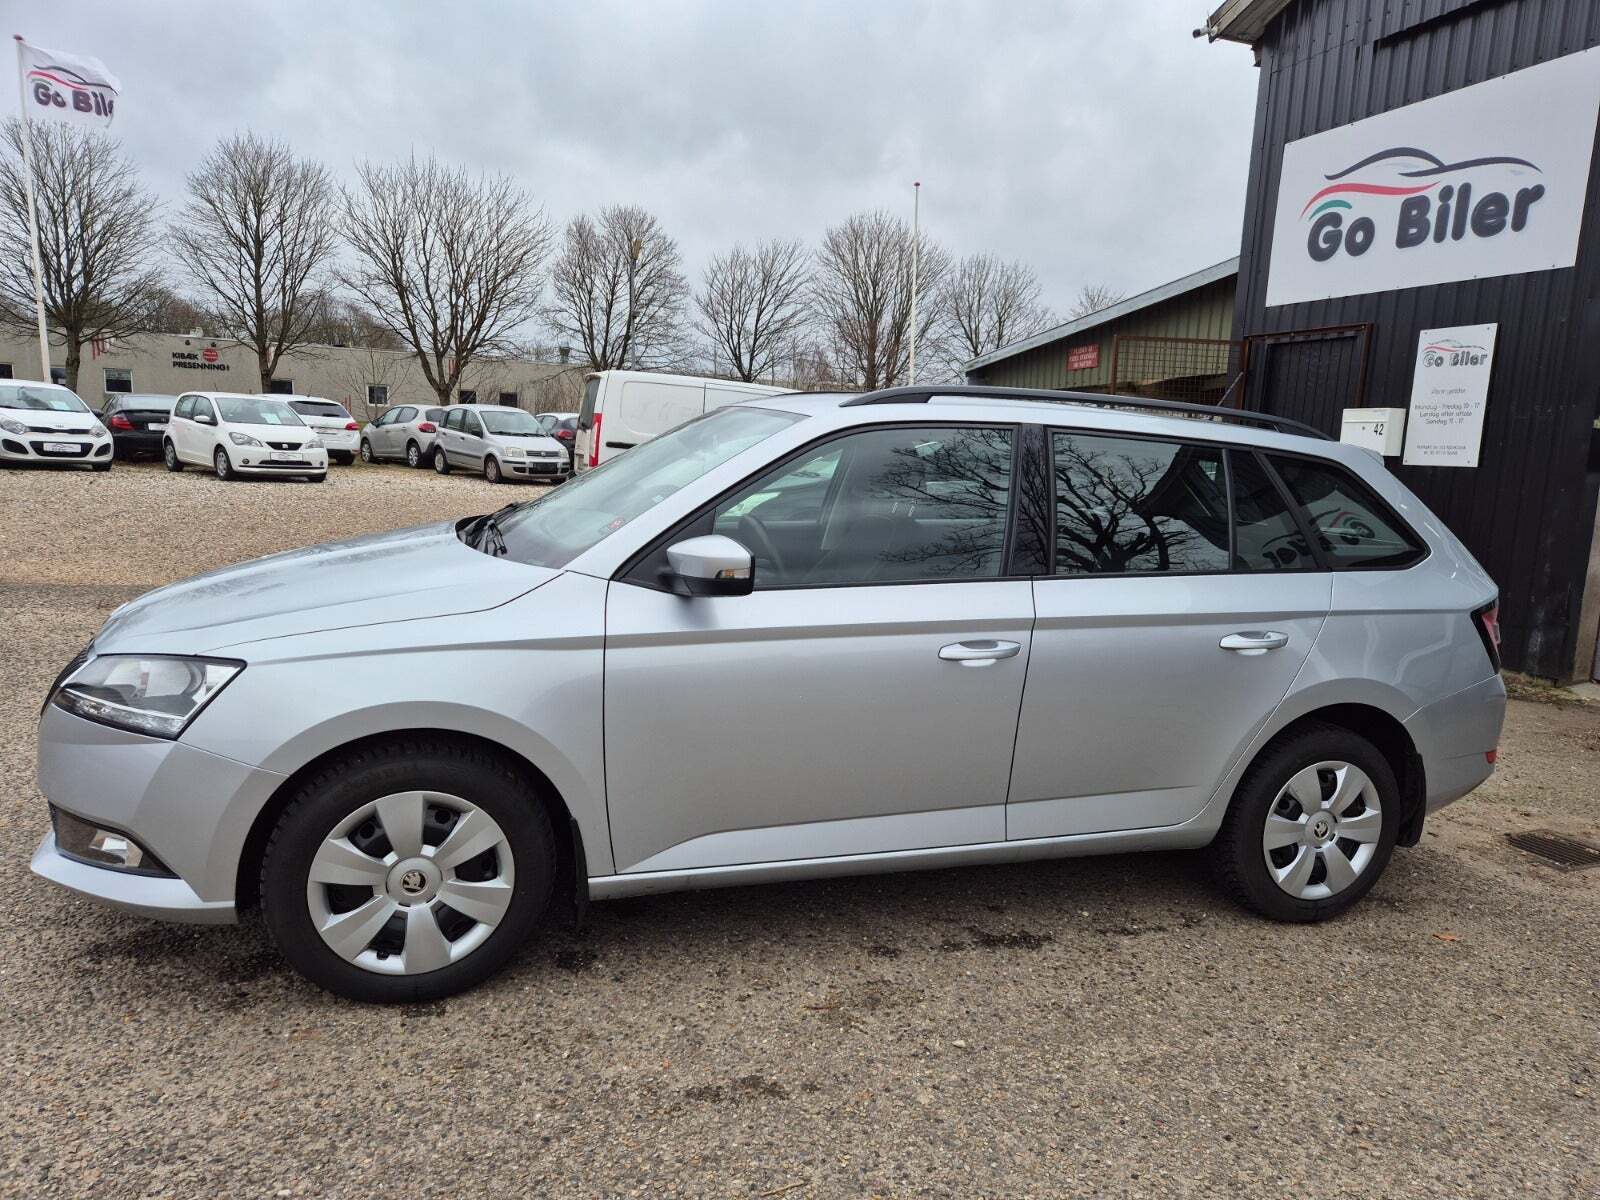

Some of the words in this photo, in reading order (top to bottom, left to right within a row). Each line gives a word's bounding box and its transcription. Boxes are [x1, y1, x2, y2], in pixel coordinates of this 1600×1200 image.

[34, 82, 66, 108] Go
[1307, 211, 1375, 262] Go
[1395, 182, 1546, 249] Biler
[172, 352, 199, 360] KIBÆK
[1423, 353, 1444, 367] Go
[1449, 351, 1488, 367] Biler
[1373, 423, 1384, 436] 42
